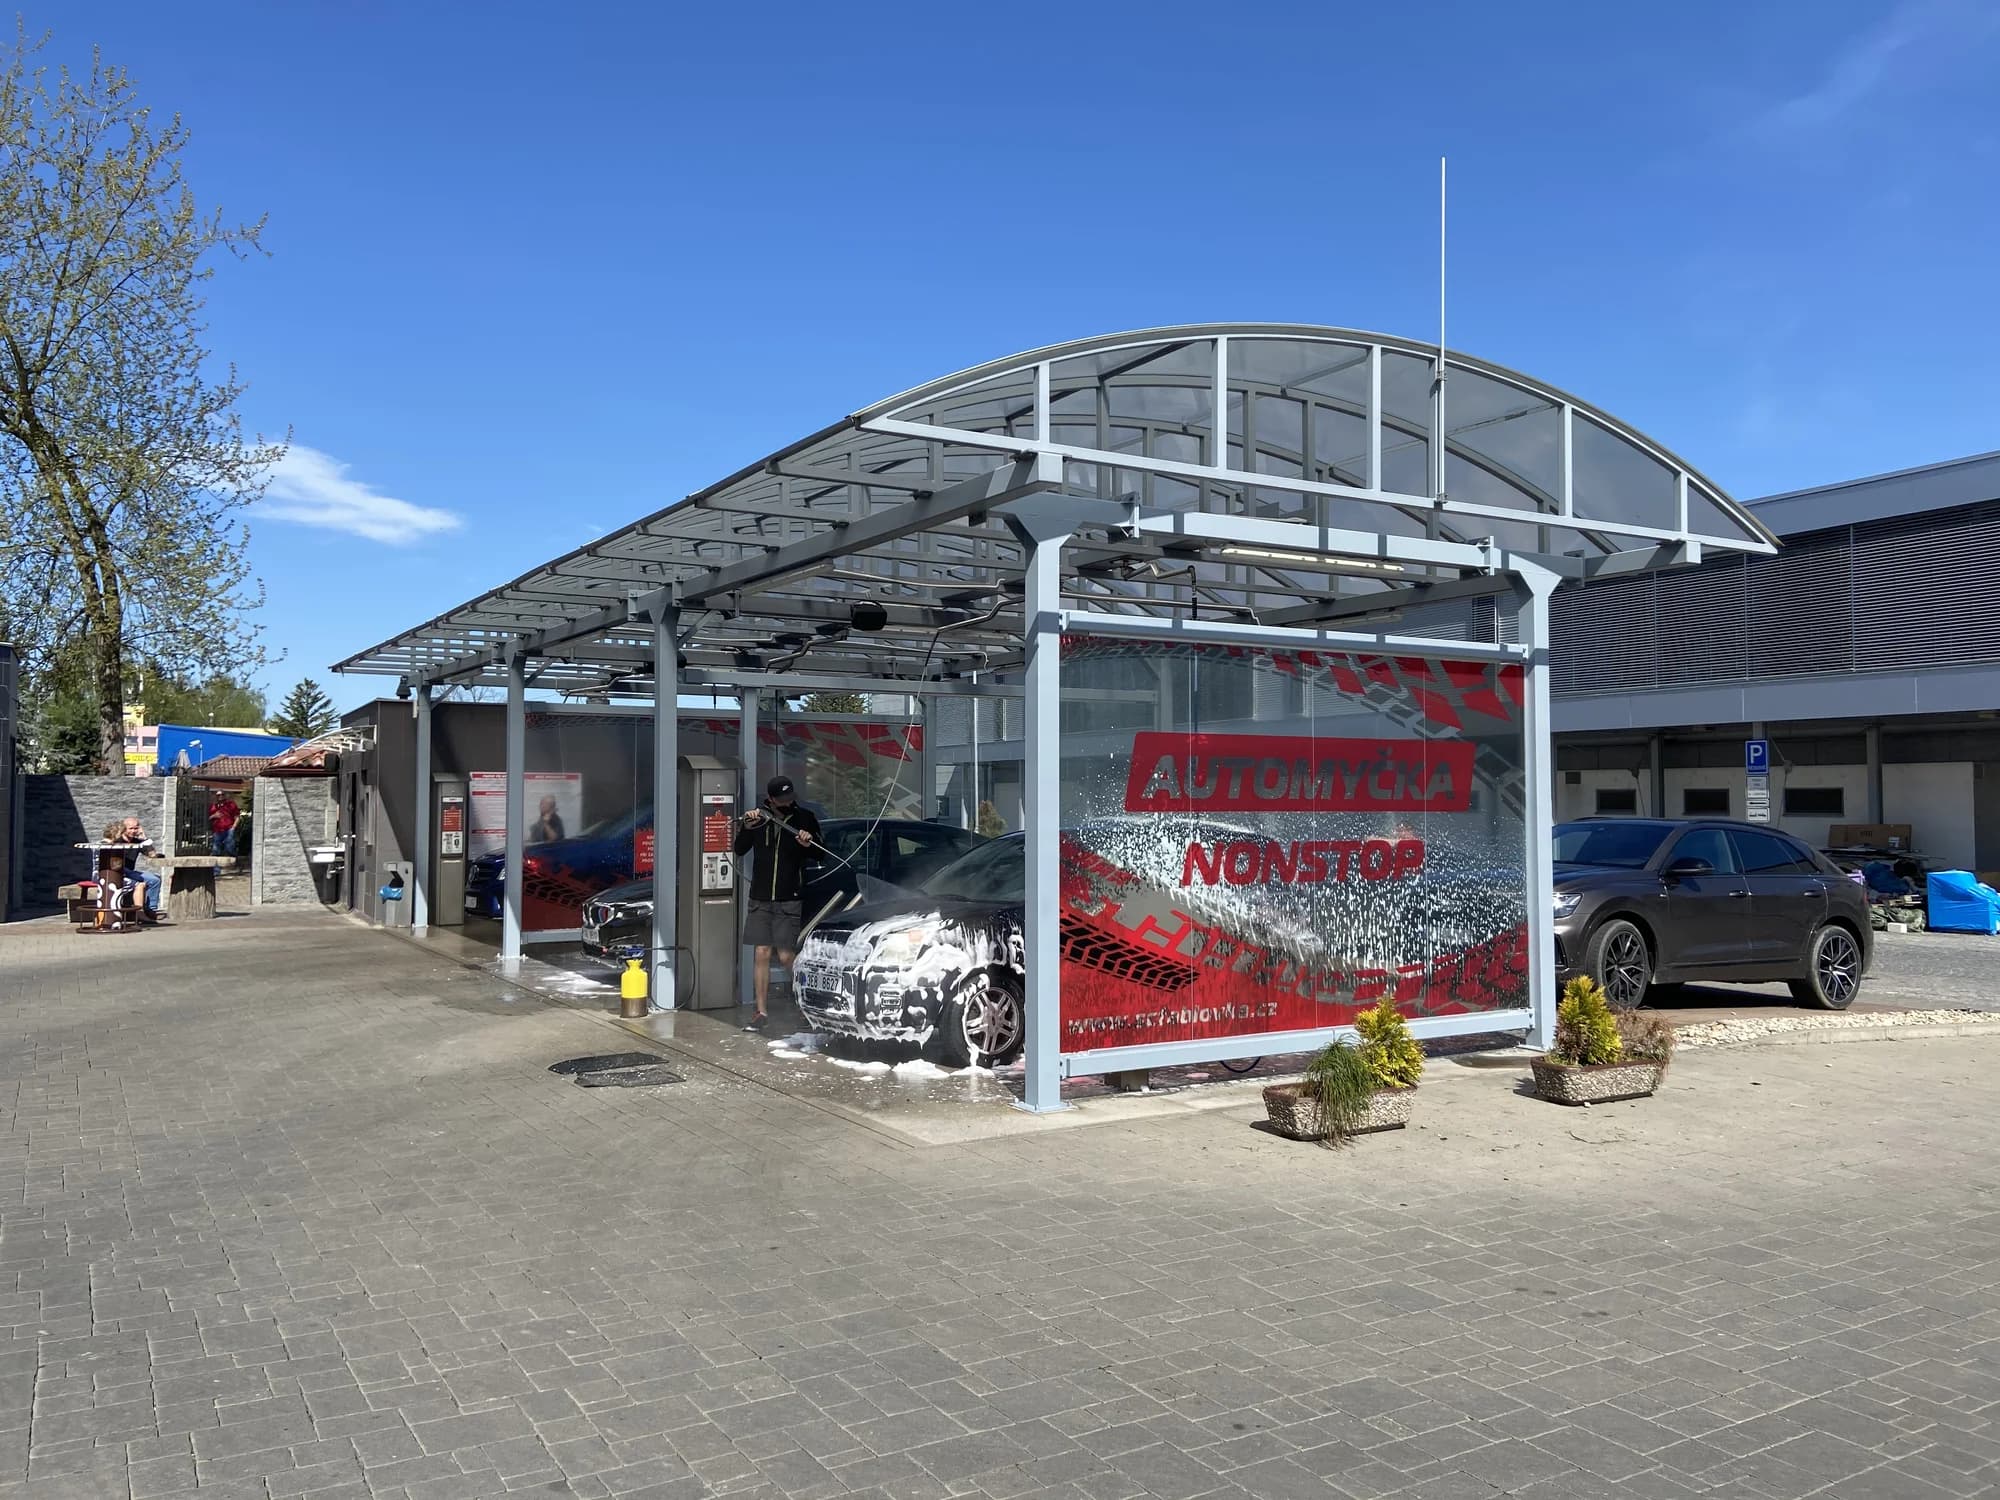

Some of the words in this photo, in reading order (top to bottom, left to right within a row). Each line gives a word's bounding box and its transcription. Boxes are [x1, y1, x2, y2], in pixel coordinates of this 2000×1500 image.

[1141, 749, 1455, 800] AUTOMYČKA
[1750, 745, 1762, 764] P
[1180, 839, 1425, 887] NONSTOP
